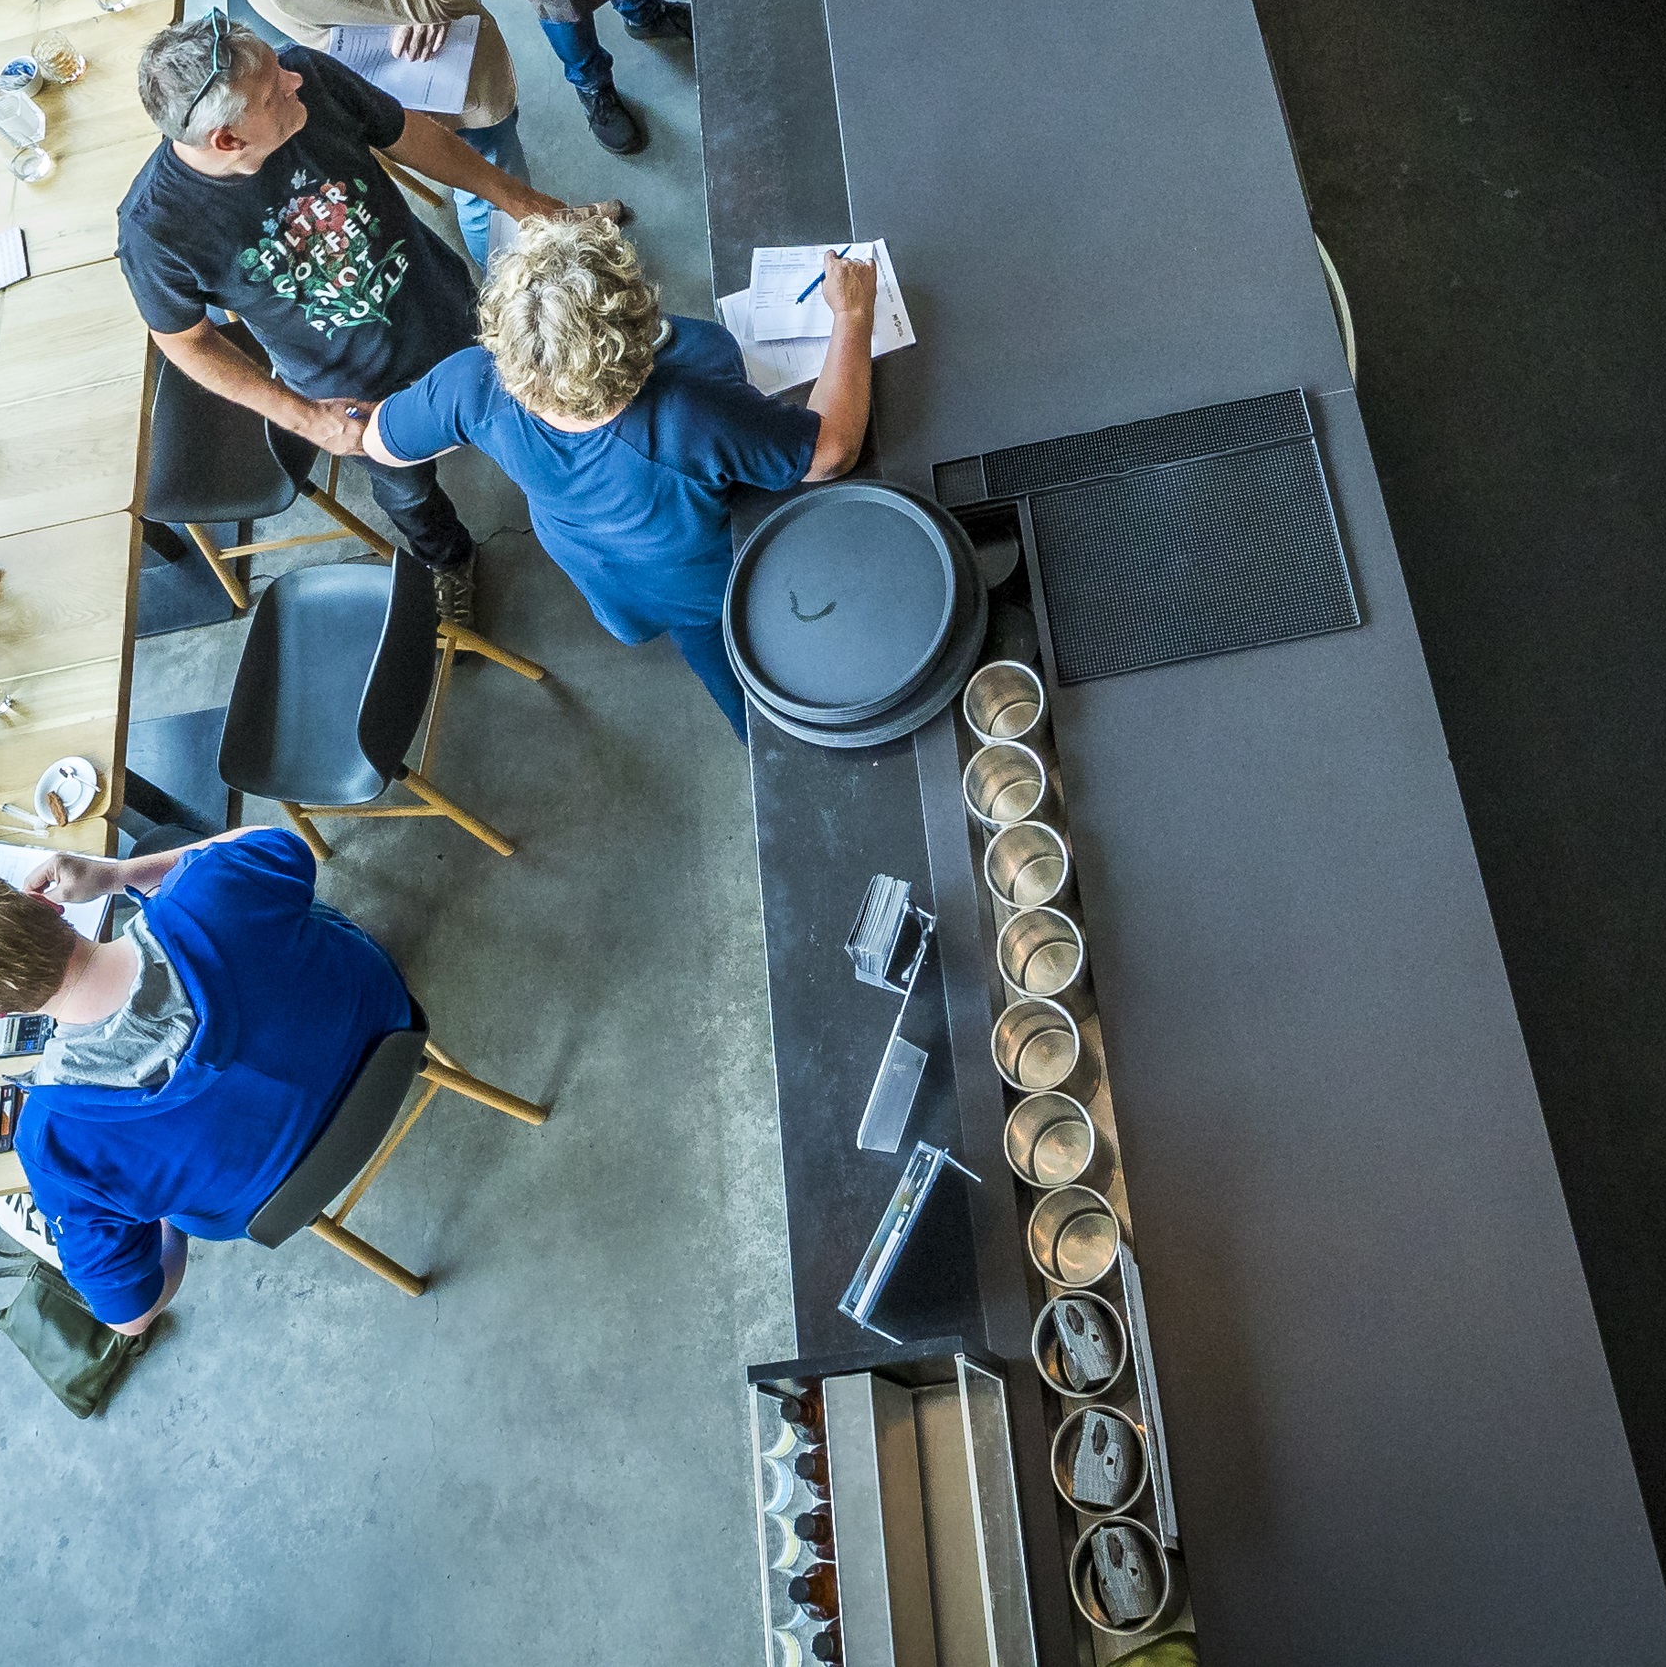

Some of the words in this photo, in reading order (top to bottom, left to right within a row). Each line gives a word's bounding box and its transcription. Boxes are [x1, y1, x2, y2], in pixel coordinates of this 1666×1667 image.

[259, 186, 348, 271] FILTER
[275, 203, 372, 294] COFFEE
[309, 255, 409, 332] PEOPLE
[314, 246, 374, 306] NOT
